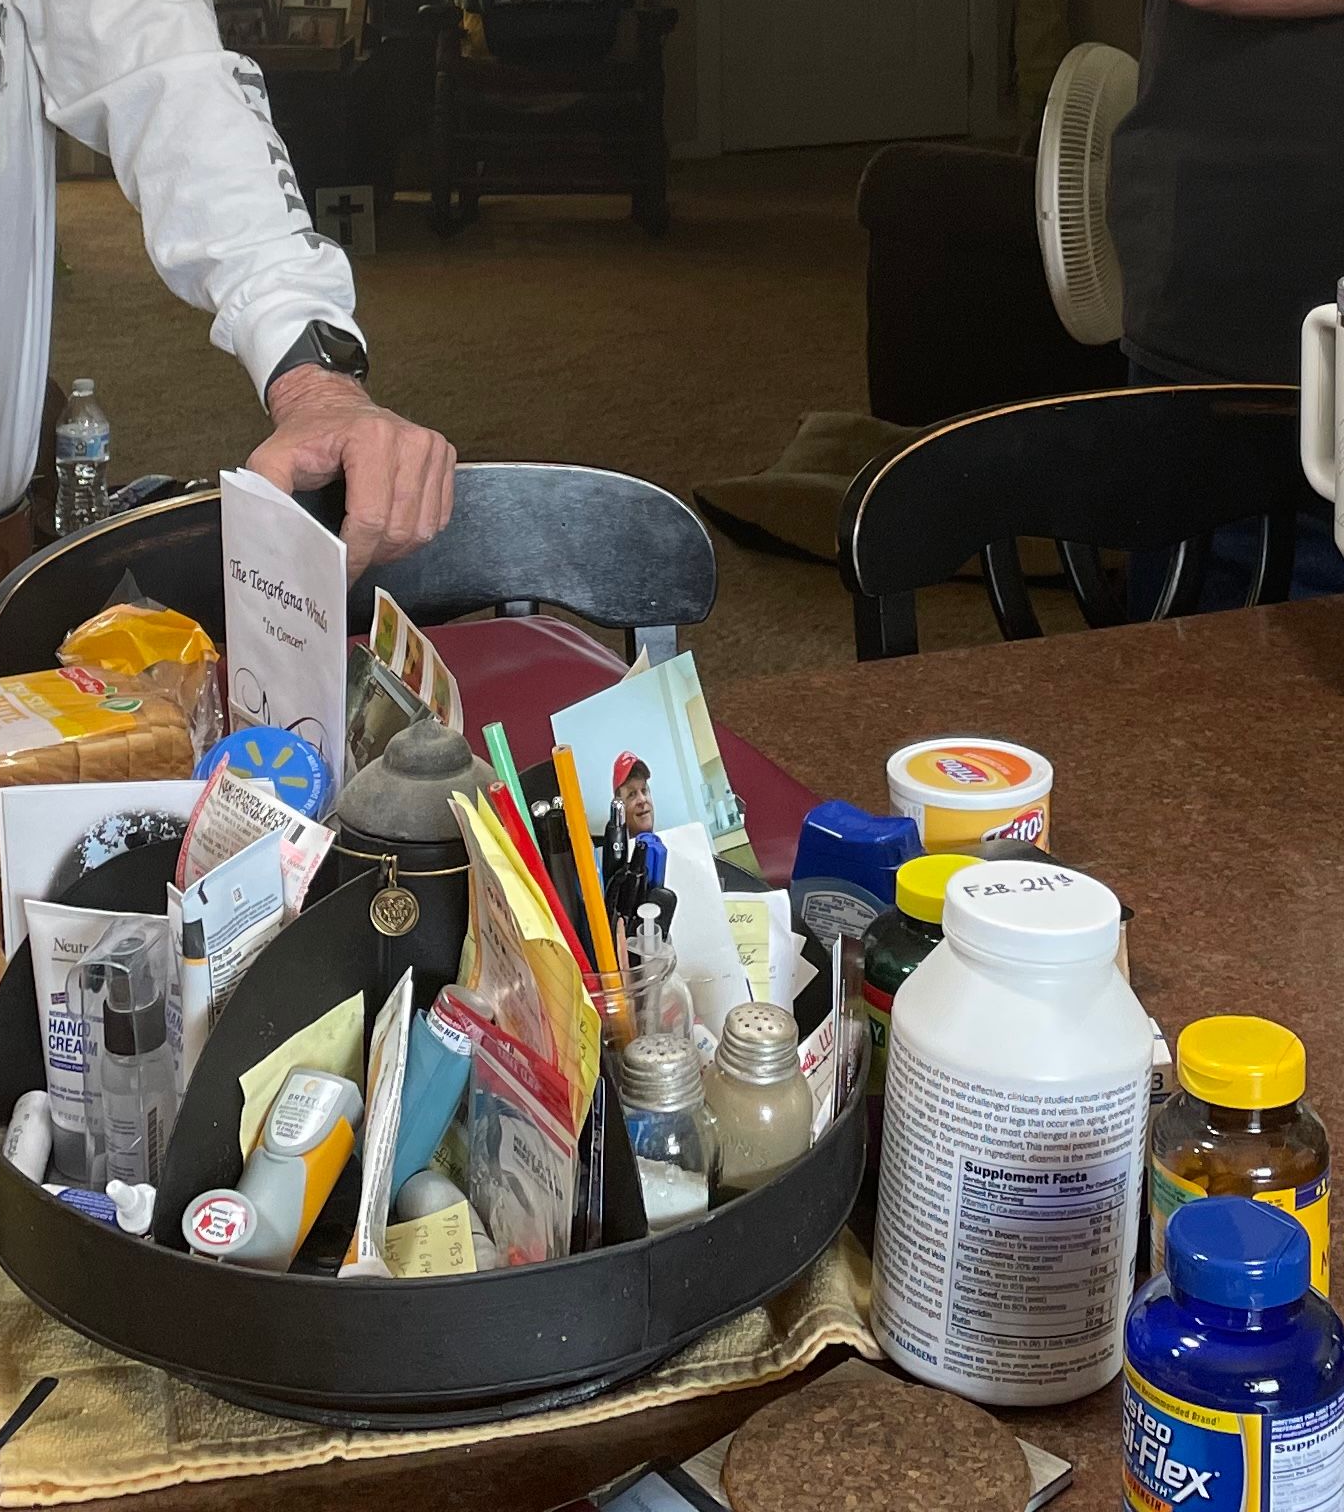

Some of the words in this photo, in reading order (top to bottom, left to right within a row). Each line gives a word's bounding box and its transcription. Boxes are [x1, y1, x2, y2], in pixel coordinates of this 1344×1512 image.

[229, 558, 247, 584] The
[248, 569, 303, 612] Texarkana
[47, 1017, 92, 1038] HAND
[47, 1034, 99, 1058] CREAM
[967, 1094, 1011, 1112] challenged
[971, 1084, 1007, 1100] effective,
[1007, 1091, 1042, 1105] clinically
[1044, 1095, 1074, 1104] studied
[951, 1114, 983, 1130] perhaps
[1000, 1127, 1022, 1138] most
[1023, 1129, 1068, 1142] challenged
[1008, 1116, 1026, 1128] legs
[1027, 1118, 1045, 1128] that
[1045, 1119, 1069, 1128] occur
[963, 1160, 1049, 1186] Supplement
[1052, 1171, 1088, 1185] Facts
[895, 1334, 938, 1366] ALLERGENS
[1121, 1380, 1172, 1444] Osteo
[1140, 1384, 1191, 1420] Recommended
